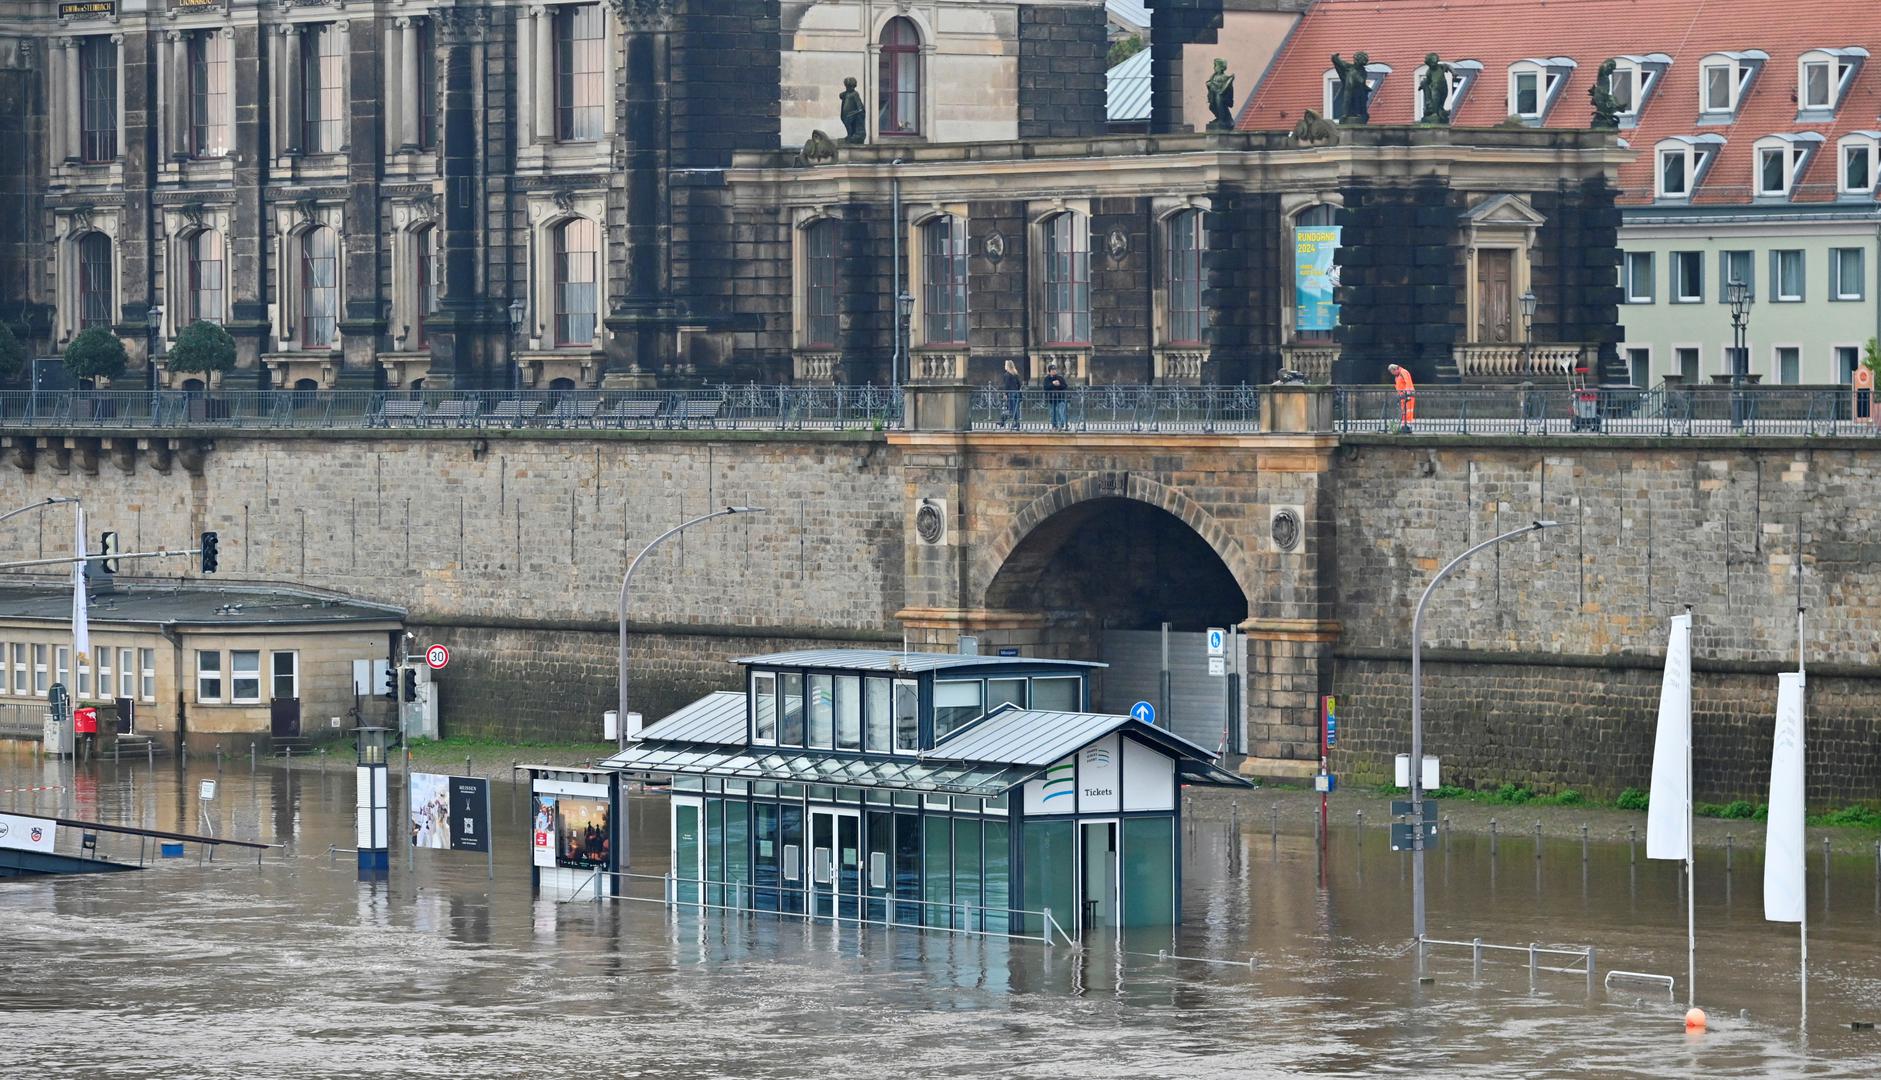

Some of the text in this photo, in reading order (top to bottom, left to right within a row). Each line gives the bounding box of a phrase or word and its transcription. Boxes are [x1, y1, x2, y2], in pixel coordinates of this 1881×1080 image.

[1298, 232, 1335, 242] RUNDGANG
[1298, 244, 1315, 253] 2024
[431, 651, 444, 662] 30
[1084, 788, 1113, 797] Tickets
